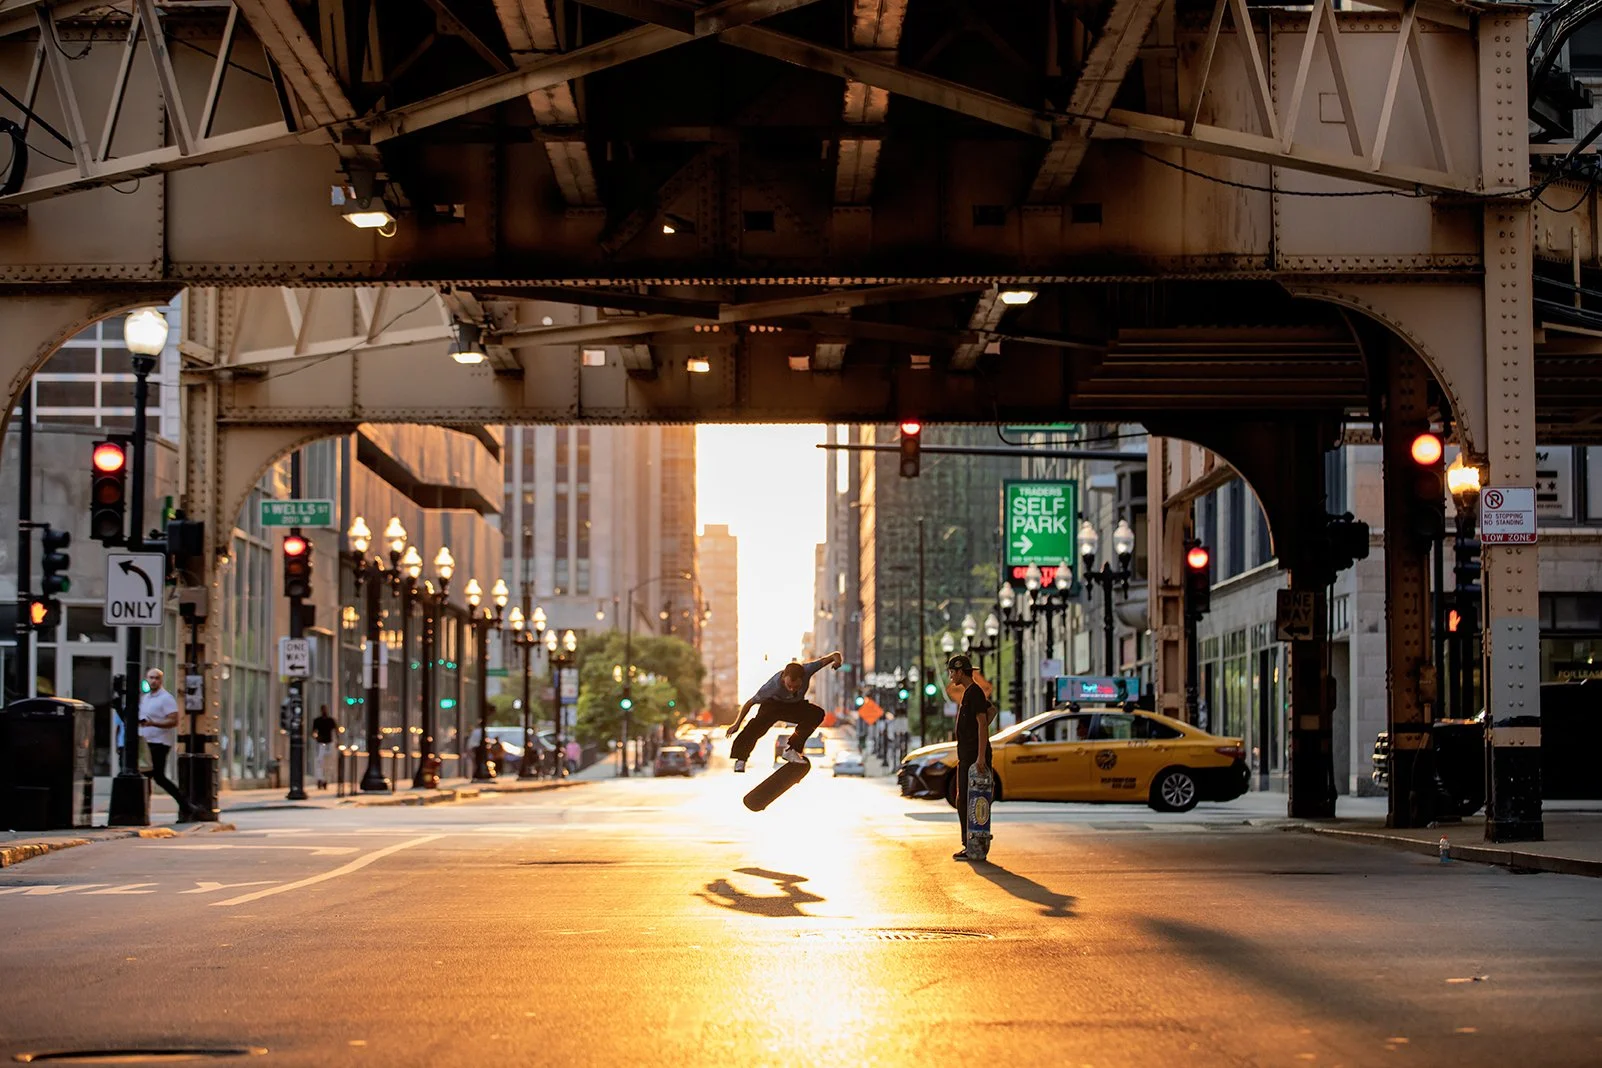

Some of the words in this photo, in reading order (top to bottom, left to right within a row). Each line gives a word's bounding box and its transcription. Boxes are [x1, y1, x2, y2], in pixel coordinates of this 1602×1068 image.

[272, 503, 316, 515] WELLS
[1012, 497, 1066, 516] SELF
[1012, 516, 1067, 535] PARK
[1282, 593, 1311, 606] ONE
[111, 600, 157, 619] ONLY
[1281, 608, 1311, 621] WAY
[287, 643, 305, 651] ONE
[286, 653, 306, 661] WAY
[1558, 670, 1577, 679] FOR
[0, 881, 284, 895] NLY
